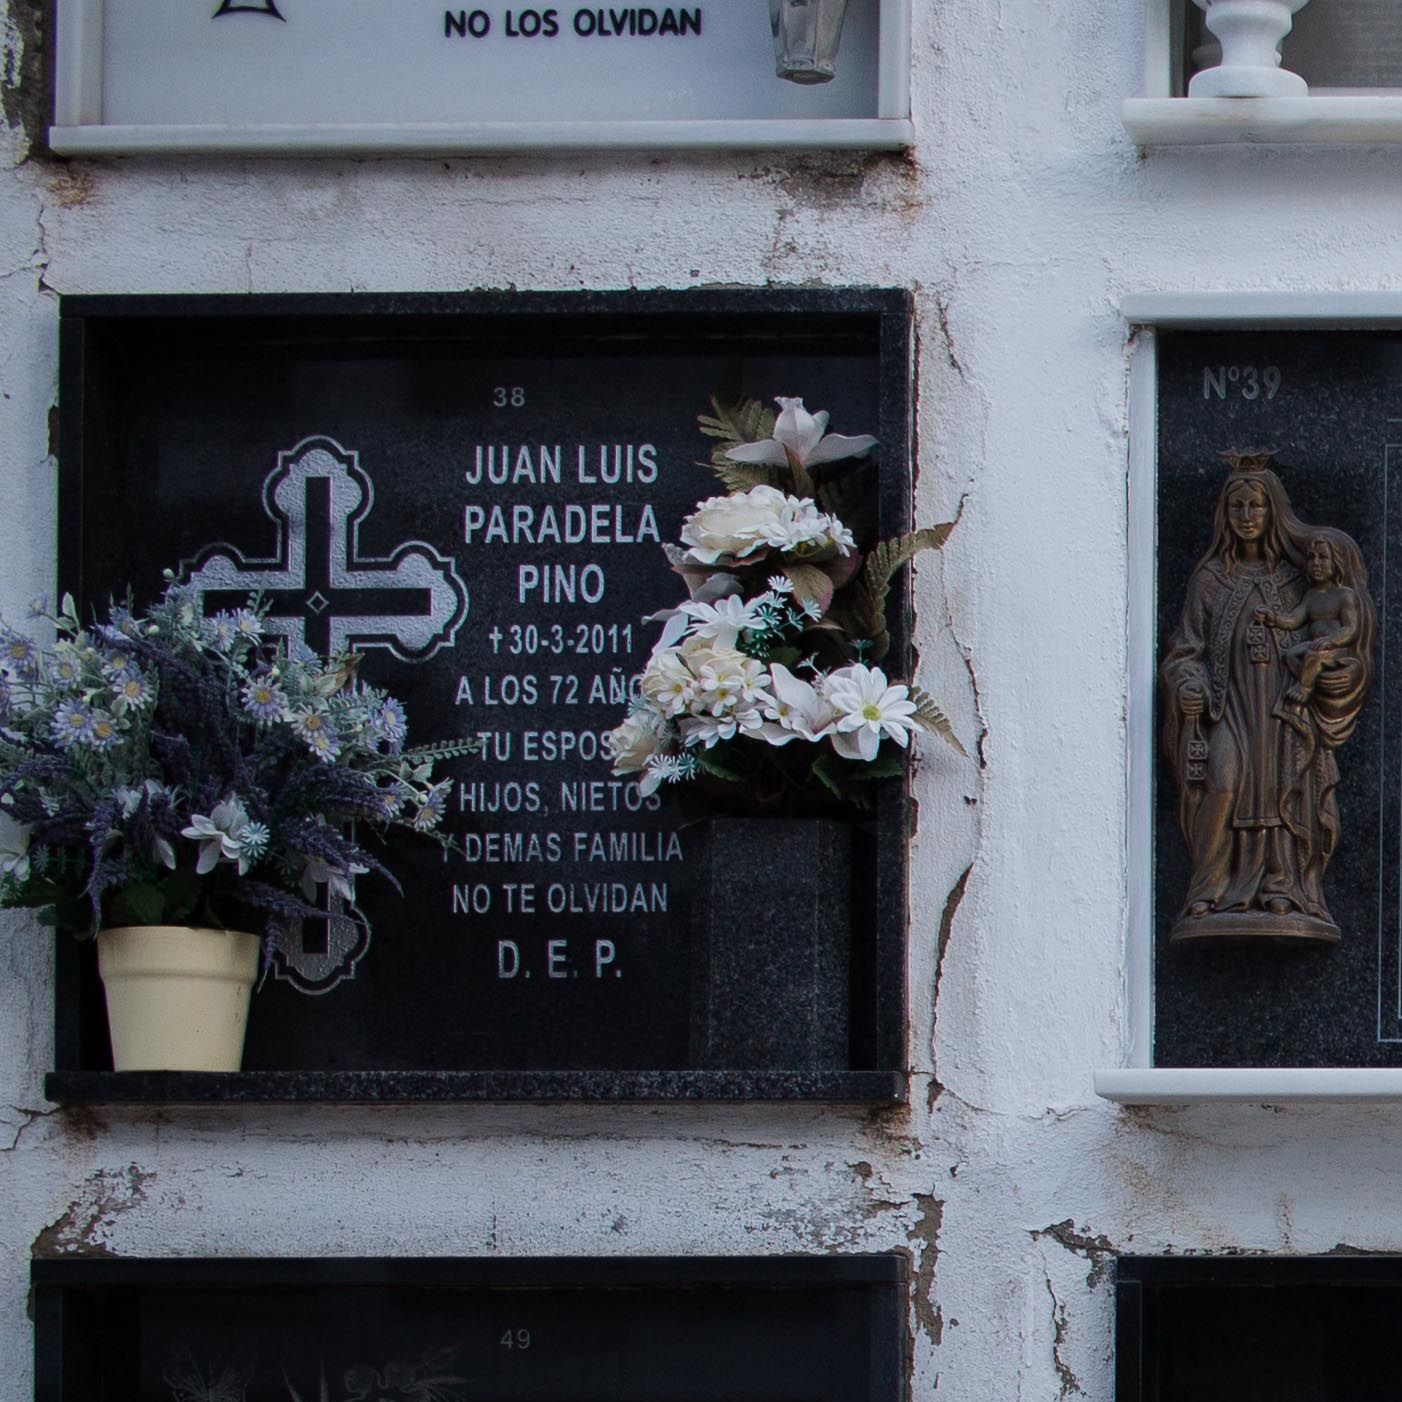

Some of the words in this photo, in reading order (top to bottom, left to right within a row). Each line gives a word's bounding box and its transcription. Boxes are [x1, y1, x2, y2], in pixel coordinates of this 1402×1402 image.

[444, 9, 491, 39] NO
[504, 8, 560, 38] LOS
[573, 7, 702, 38] OLVIDAN
[492, 386, 526, 408] 38
[1202, 365, 1282, 400] Nº39
[465, 444, 561, 485] JUAN
[578, 443, 658, 484] LUIS
[464, 504, 661, 544] PARADELA
[518, 563, 605, 604] PINO
[509, 623, 632, 655] 30-3-2011
[455, 675, 474, 705] A
[484, 674, 538, 706] LOS
[549, 674, 579, 705] 72
[477, 732, 511, 760] TU
[460, 781, 549, 813] HIJOS,
[561, 781, 661, 812] NIETOS
[465, 831, 562, 863] DEMAS
[573, 831, 683, 862] FAMILIA
[452, 883, 491, 914] NO
[502, 883, 536, 913] TE
[547, 882, 667, 913] OLVIDAN
[500, 1328, 531, 1350] 49
